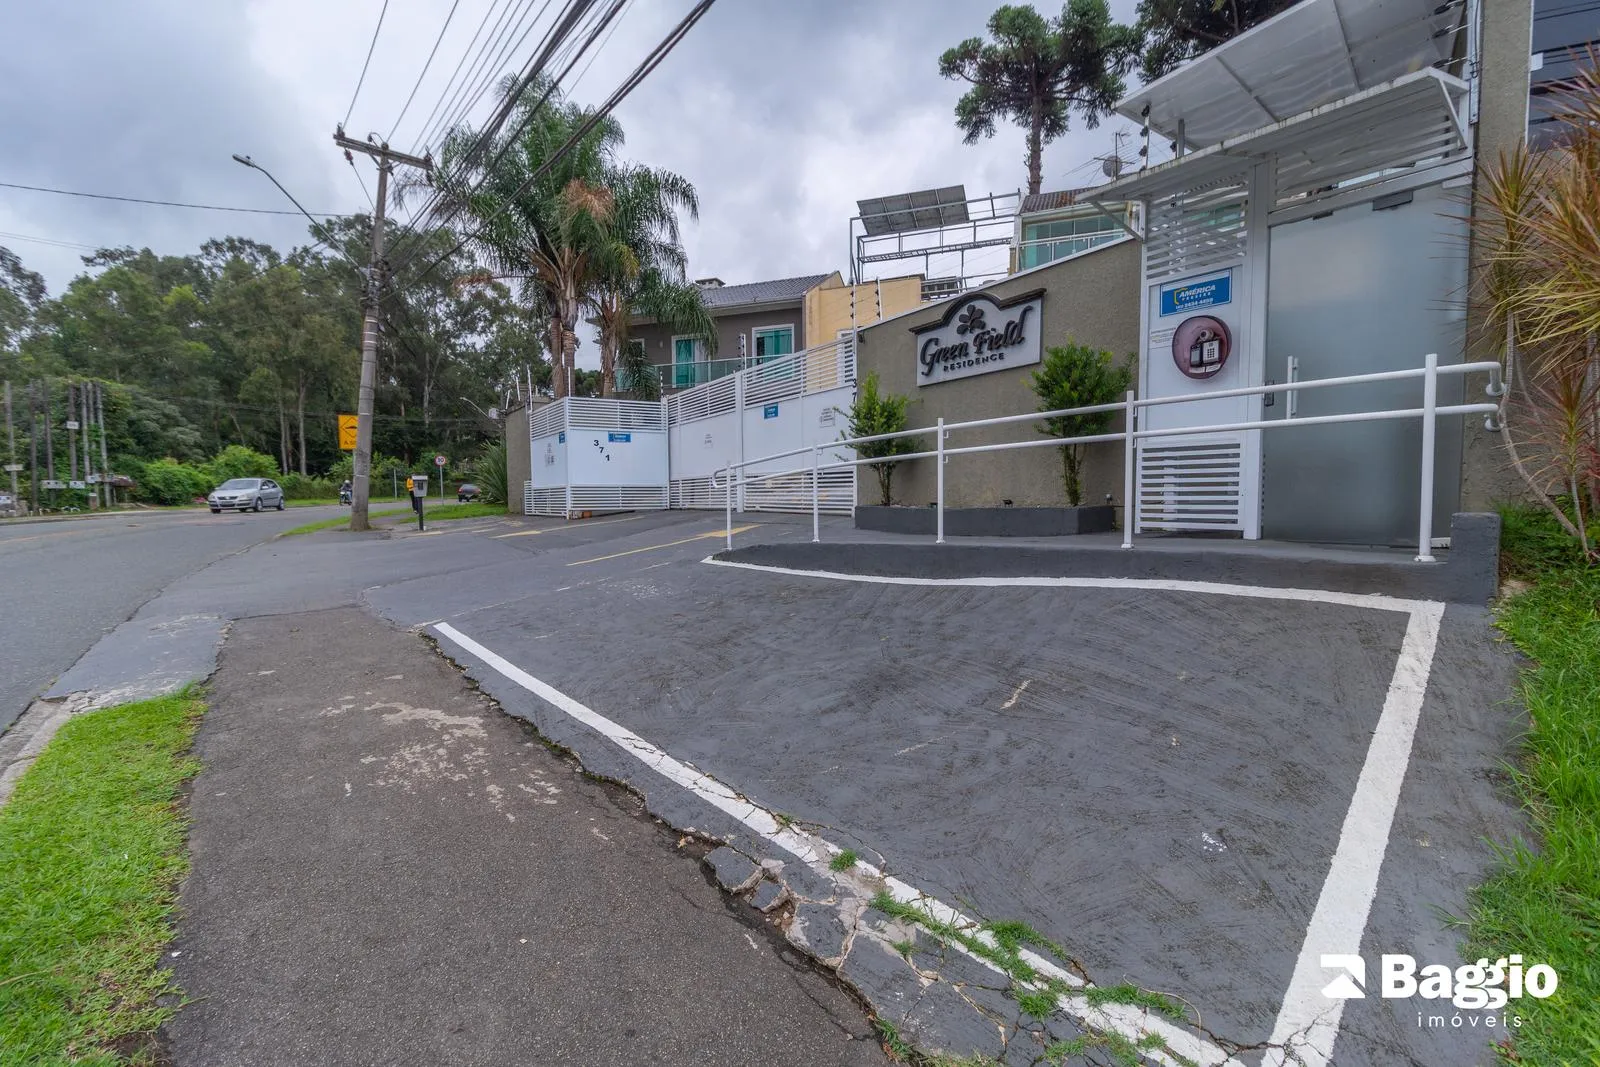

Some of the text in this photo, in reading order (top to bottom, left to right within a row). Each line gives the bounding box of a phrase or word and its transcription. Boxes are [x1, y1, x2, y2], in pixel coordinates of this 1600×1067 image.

[1178, 284, 1216, 298] AMÉRICA
[920, 305, 1033, 376] Green Field
[943, 352, 1005, 372] RESIDENCE
